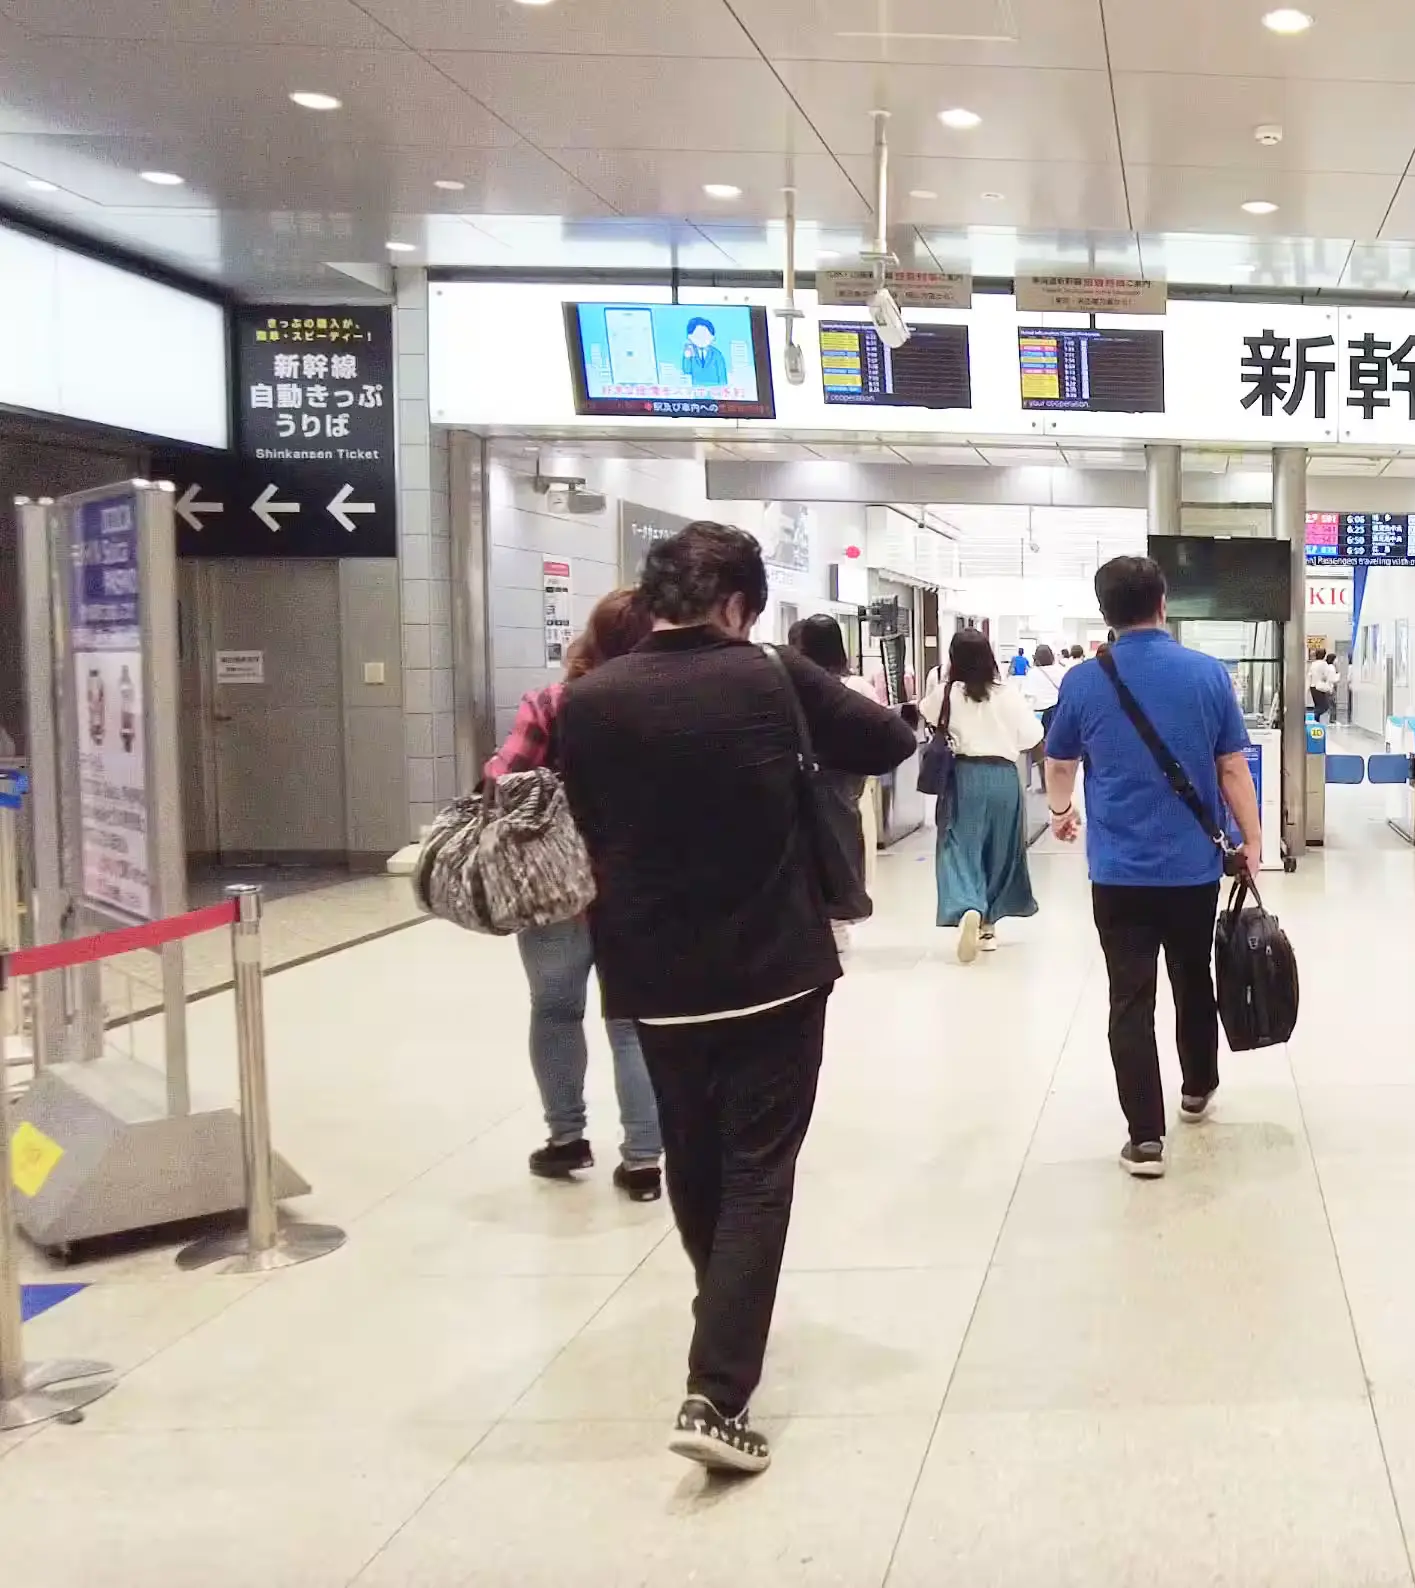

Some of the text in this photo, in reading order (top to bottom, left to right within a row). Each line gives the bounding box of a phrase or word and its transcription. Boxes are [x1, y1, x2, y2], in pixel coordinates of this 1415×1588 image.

[273, 353, 358, 380] 新幹線
[250, 383, 383, 409] 自動きっぷ
[276, 413, 350, 438] うりば
[255, 449, 380, 460] Shinkansen Ticket
[1311, 729, 1323, 737] 10
